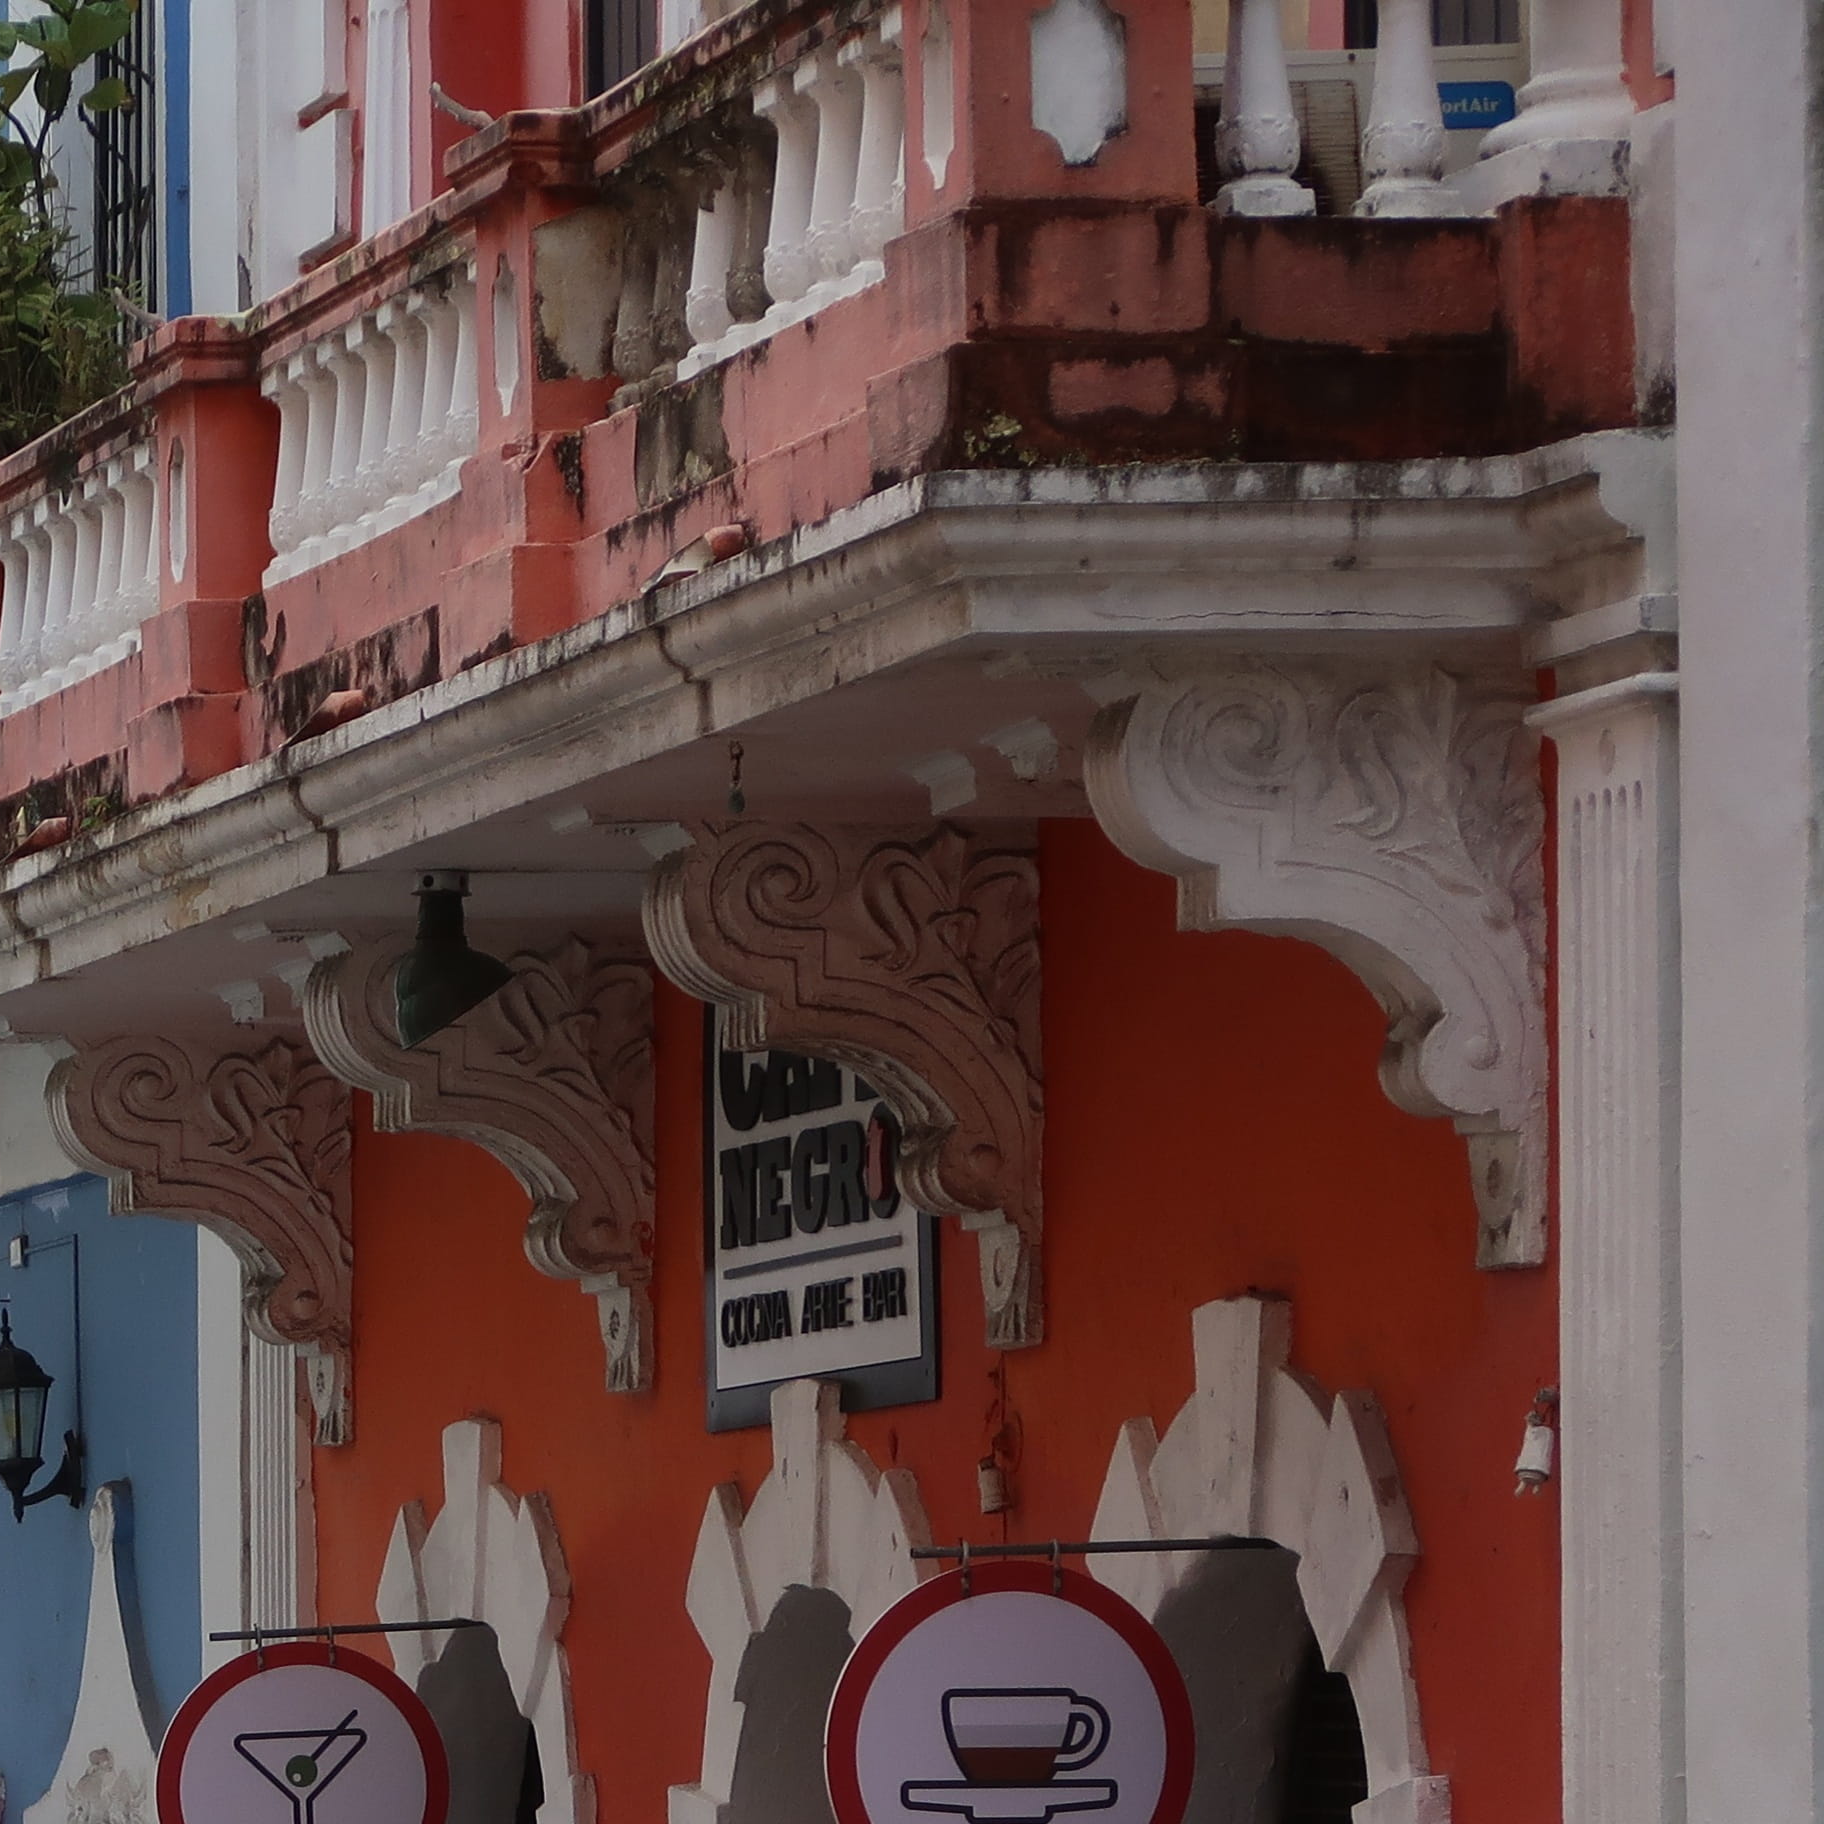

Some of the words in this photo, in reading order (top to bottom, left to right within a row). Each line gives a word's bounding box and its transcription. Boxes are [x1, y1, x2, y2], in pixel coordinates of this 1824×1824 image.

[1441, 96, 1499, 114] ortAir
[719, 1101, 901, 1250] NEGRO
[800, 1276, 855, 1335] ARTE
[861, 1266, 908, 1323] BAR
